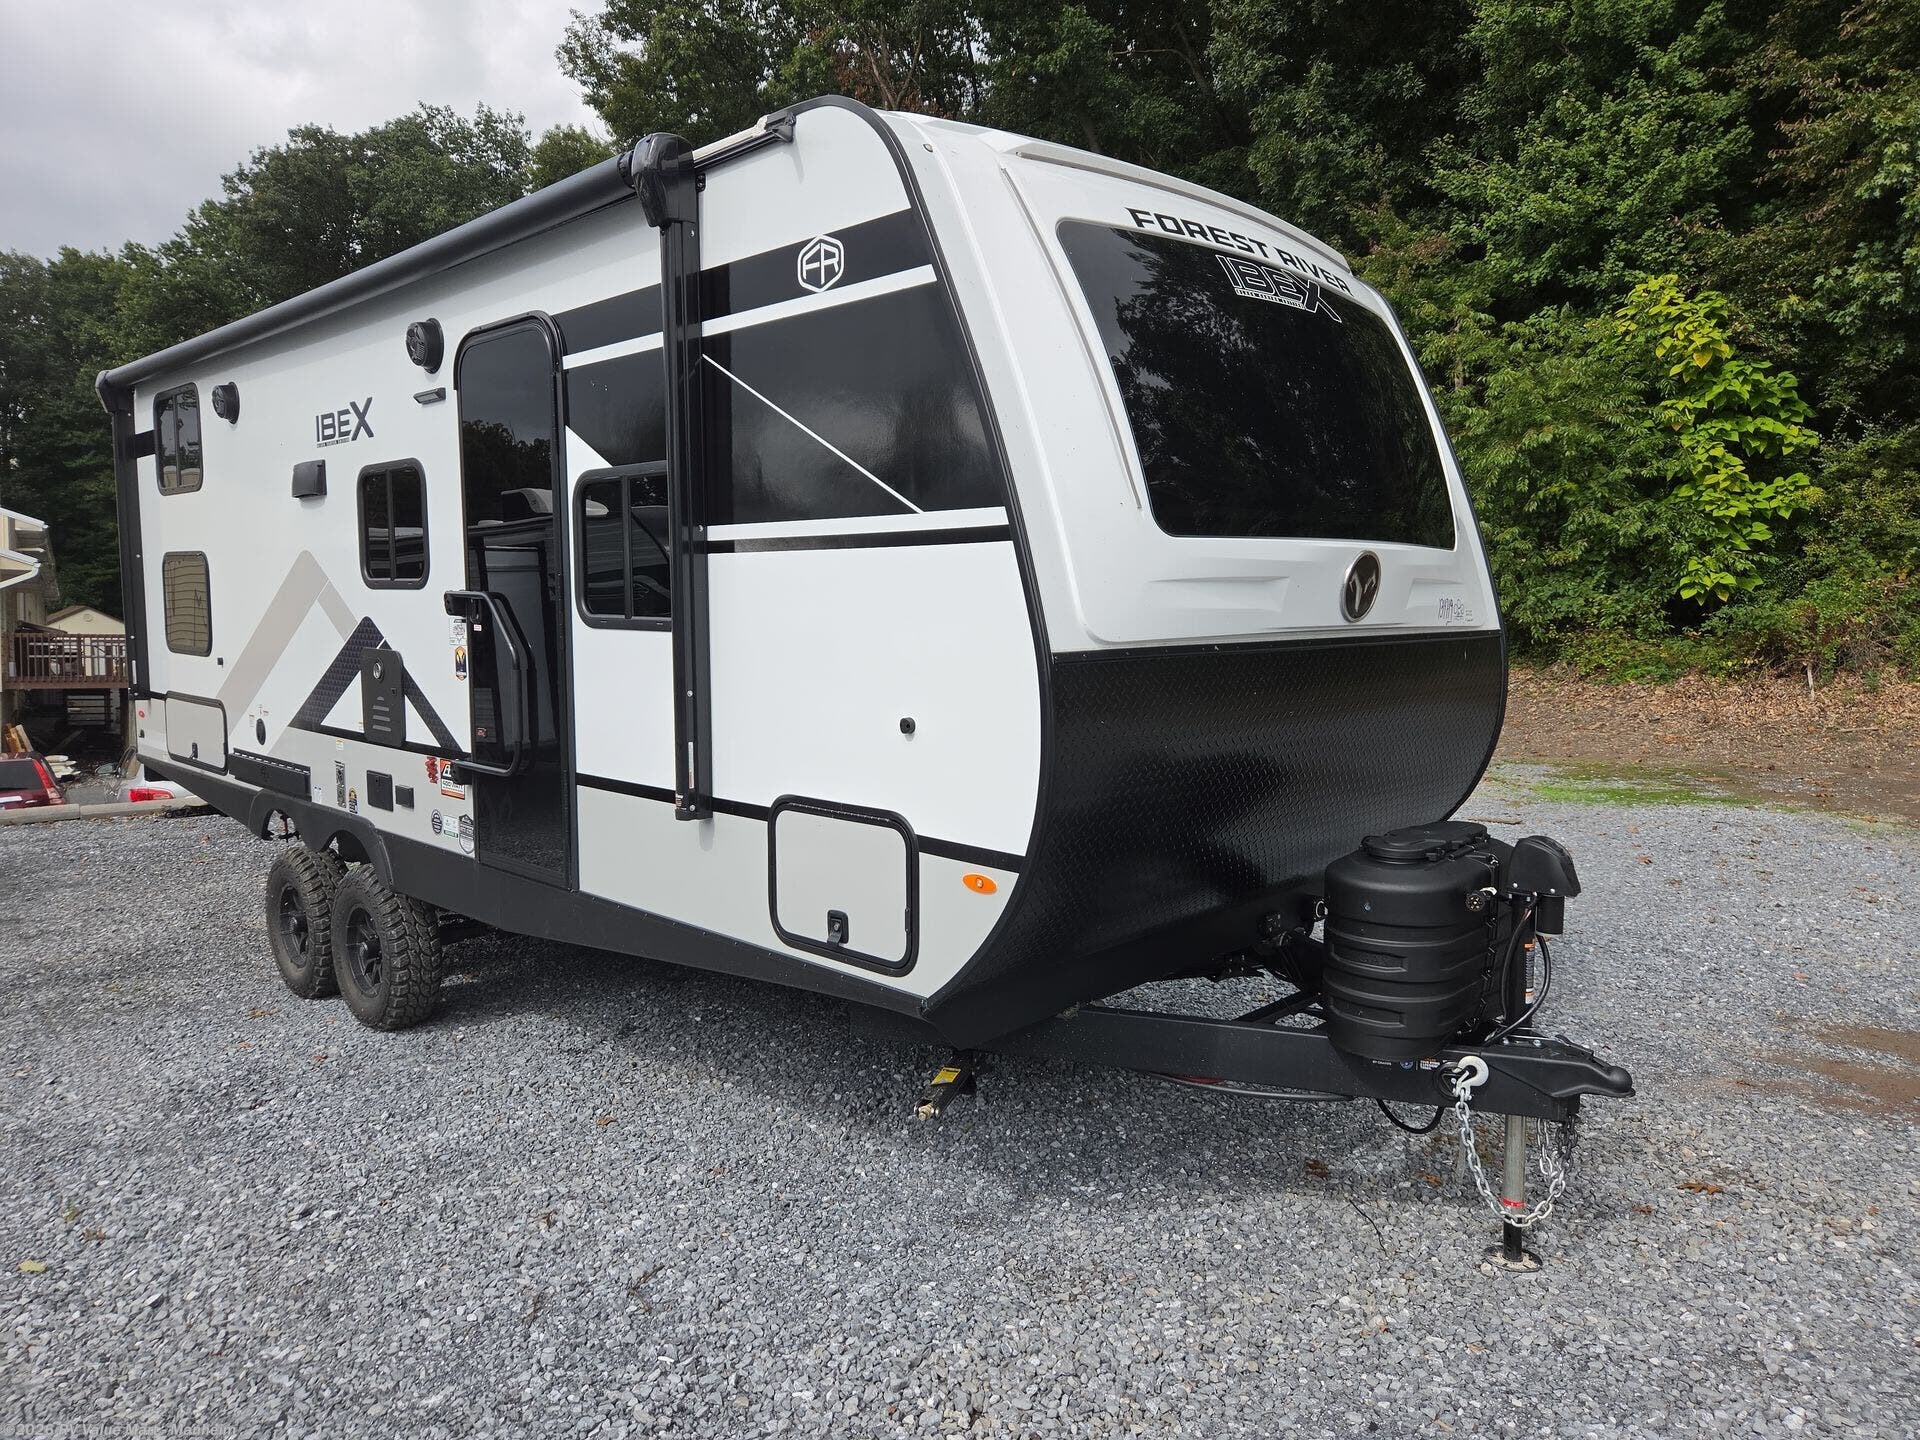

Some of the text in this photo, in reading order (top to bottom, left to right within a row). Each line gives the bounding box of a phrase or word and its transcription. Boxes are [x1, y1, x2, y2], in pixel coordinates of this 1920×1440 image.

[1125, 207, 1353, 297] FOREST RIVER
[1215, 254, 1342, 323] IBEX
[315, 396, 375, 443] IBEX
